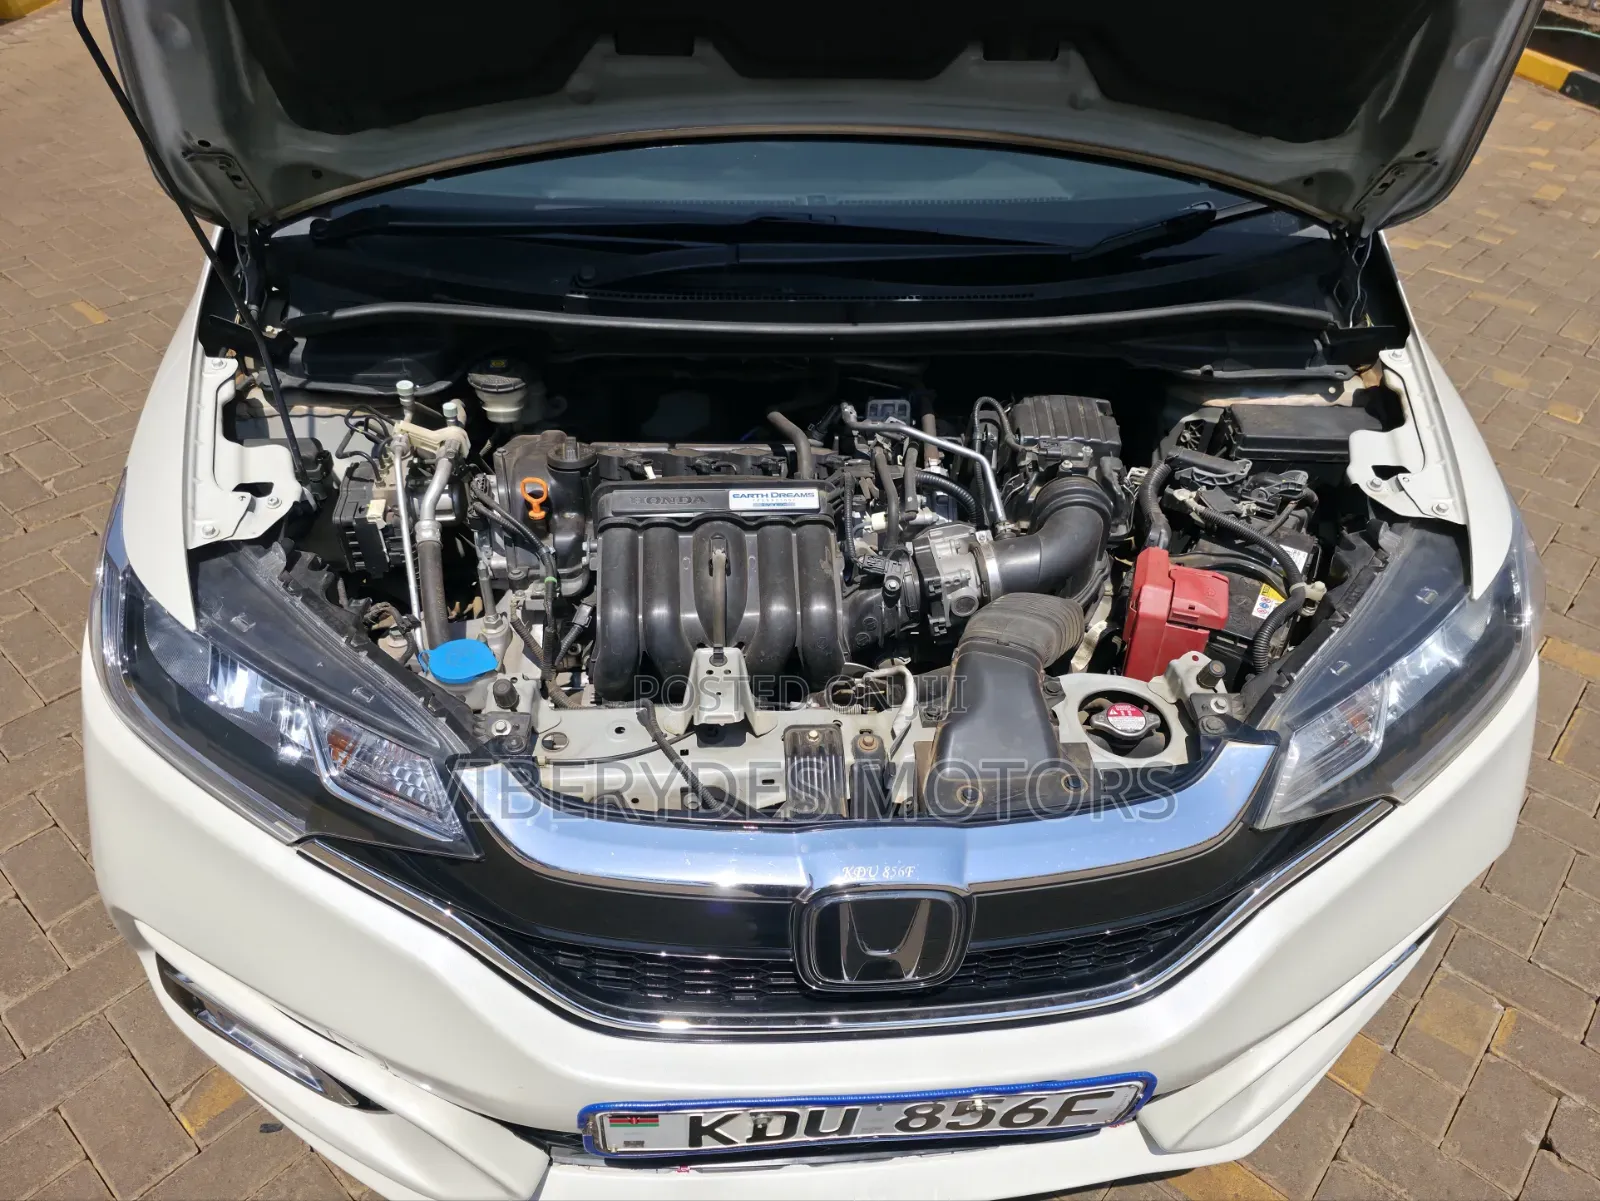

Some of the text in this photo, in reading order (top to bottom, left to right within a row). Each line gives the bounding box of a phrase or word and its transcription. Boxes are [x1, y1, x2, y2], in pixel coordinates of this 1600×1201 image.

[629, 494, 708, 506] HONDA
[842, 864, 916, 881] KDU 856F
[688, 1106, 861, 1148] KDU
[894, 1090, 1115, 1132] 856F
